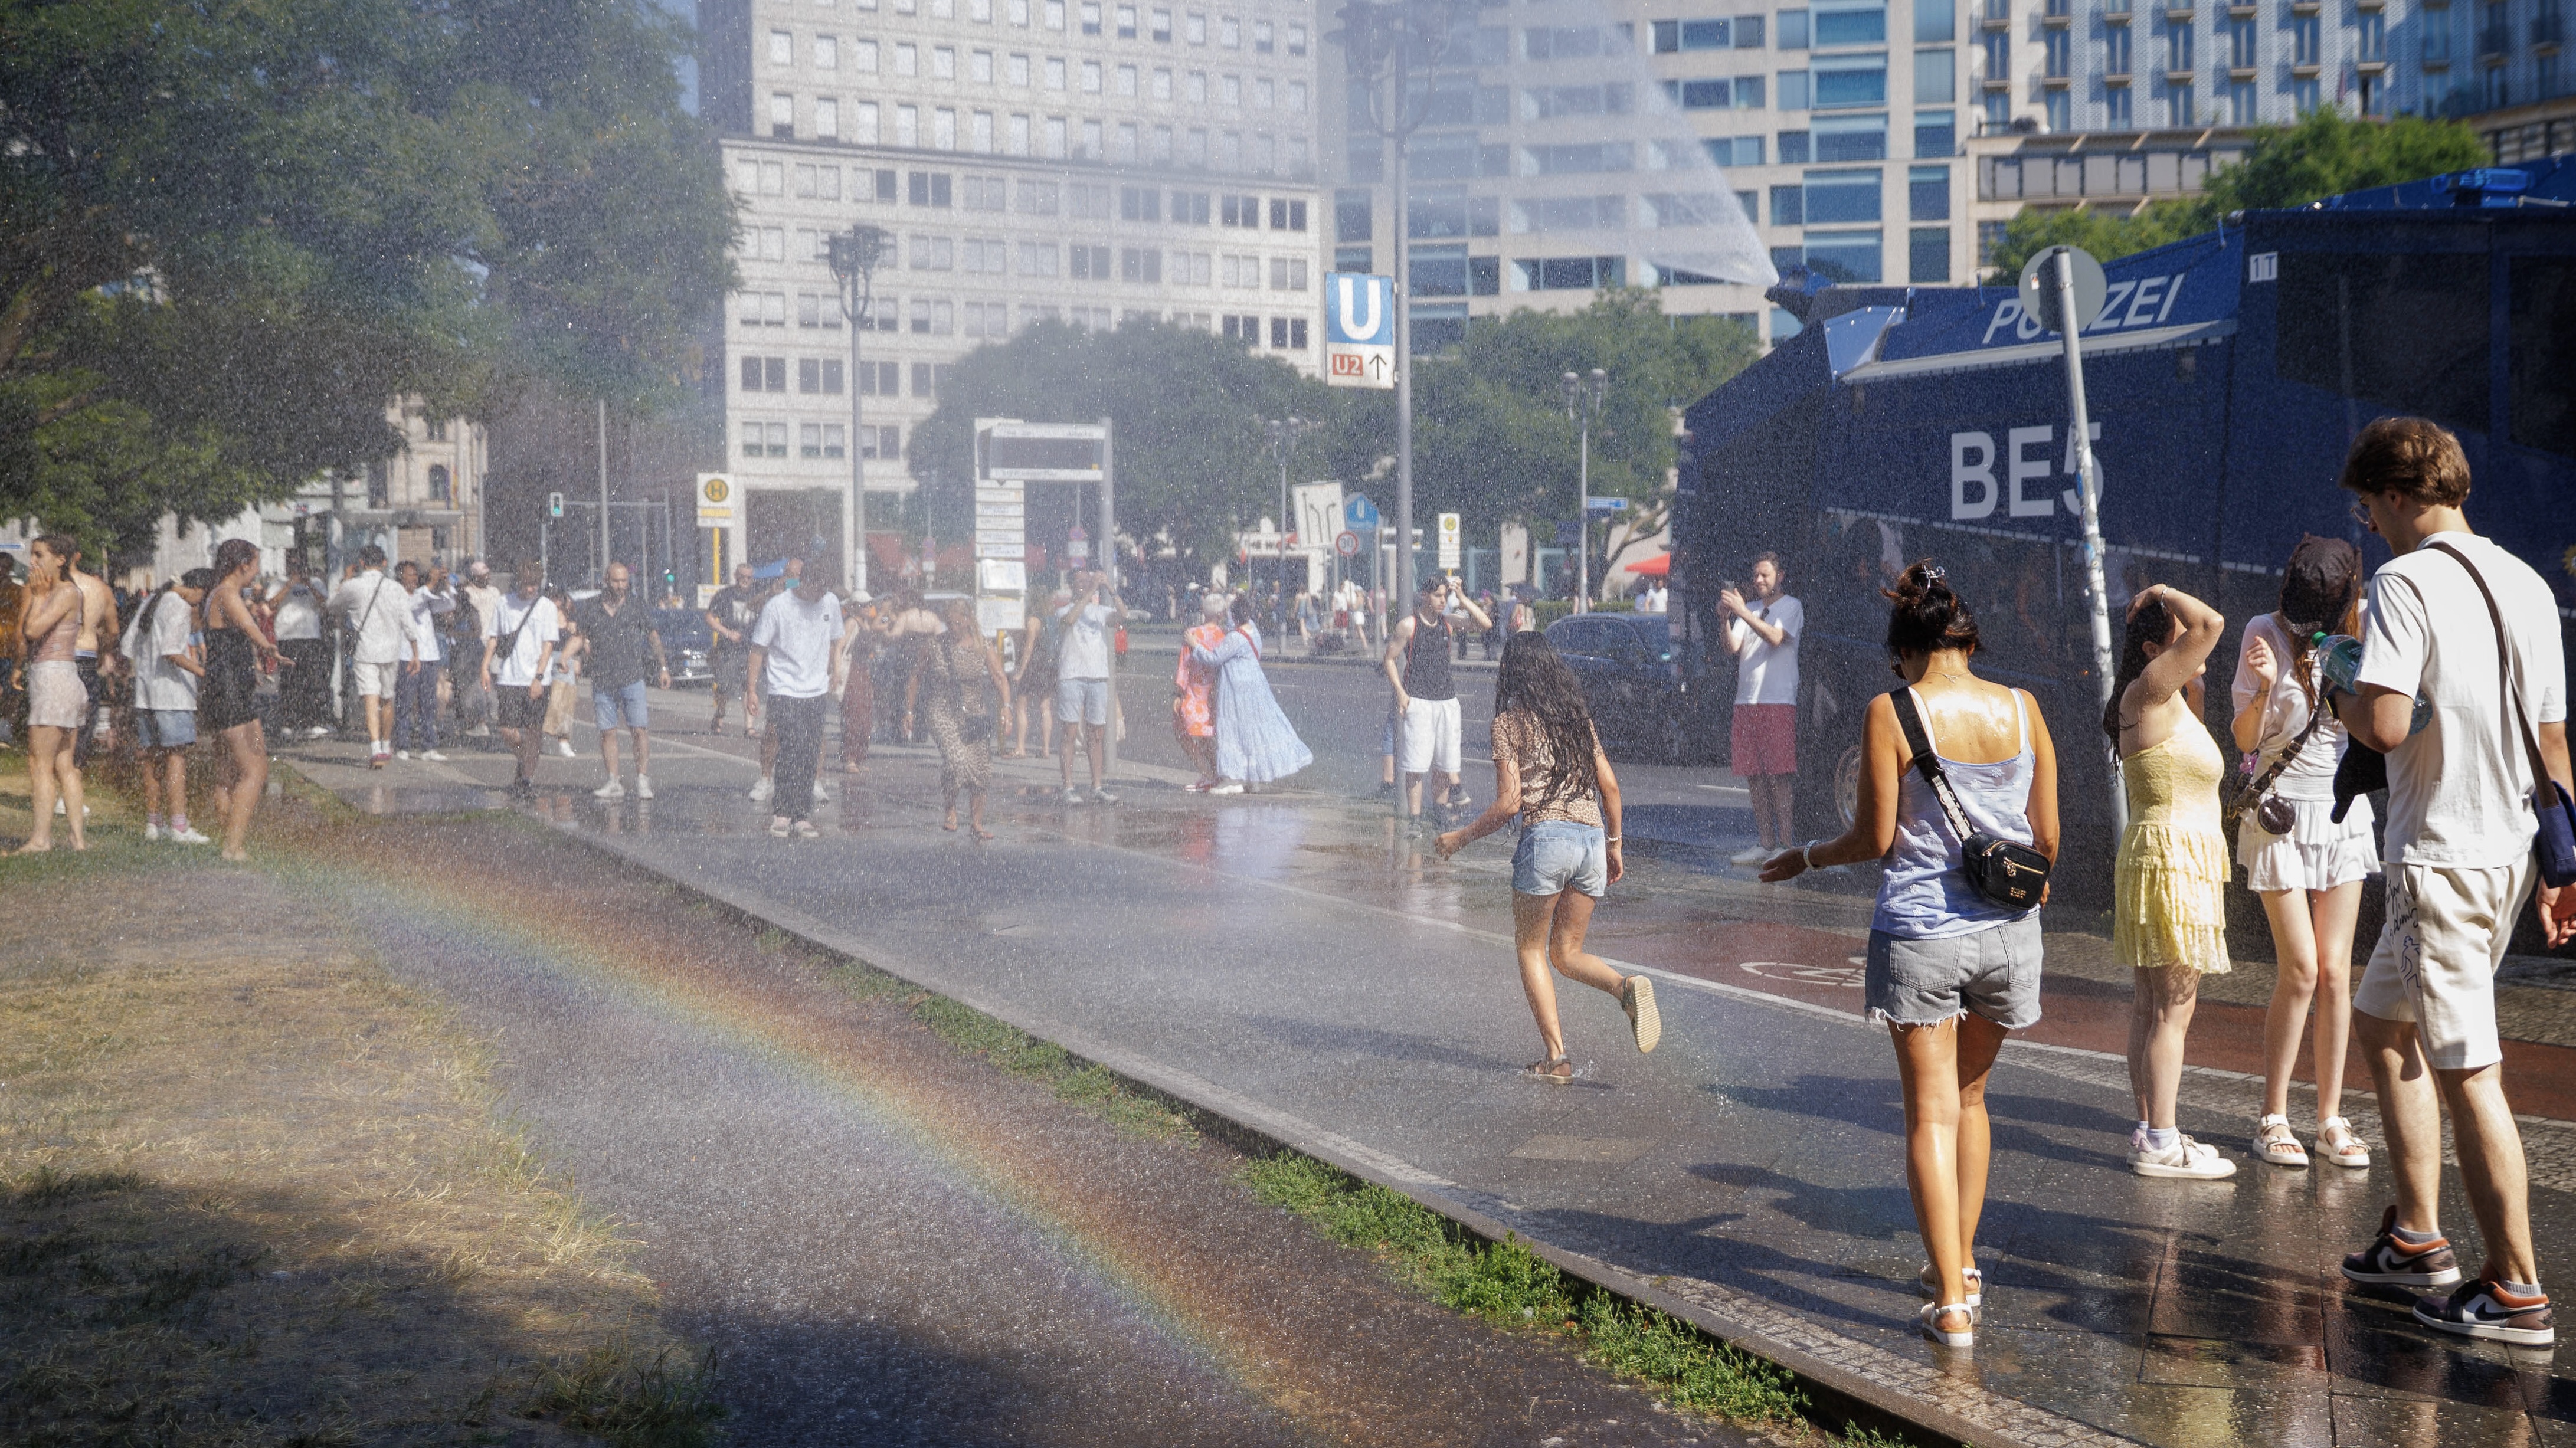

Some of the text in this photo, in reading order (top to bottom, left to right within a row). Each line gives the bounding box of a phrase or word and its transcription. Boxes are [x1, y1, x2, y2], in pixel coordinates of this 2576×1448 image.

[1338, 278, 1381, 340] U
[1335, 355, 1361, 374] U2
[1951, 421, 2104, 520] BE5
[1340, 537, 1354, 549] 30
